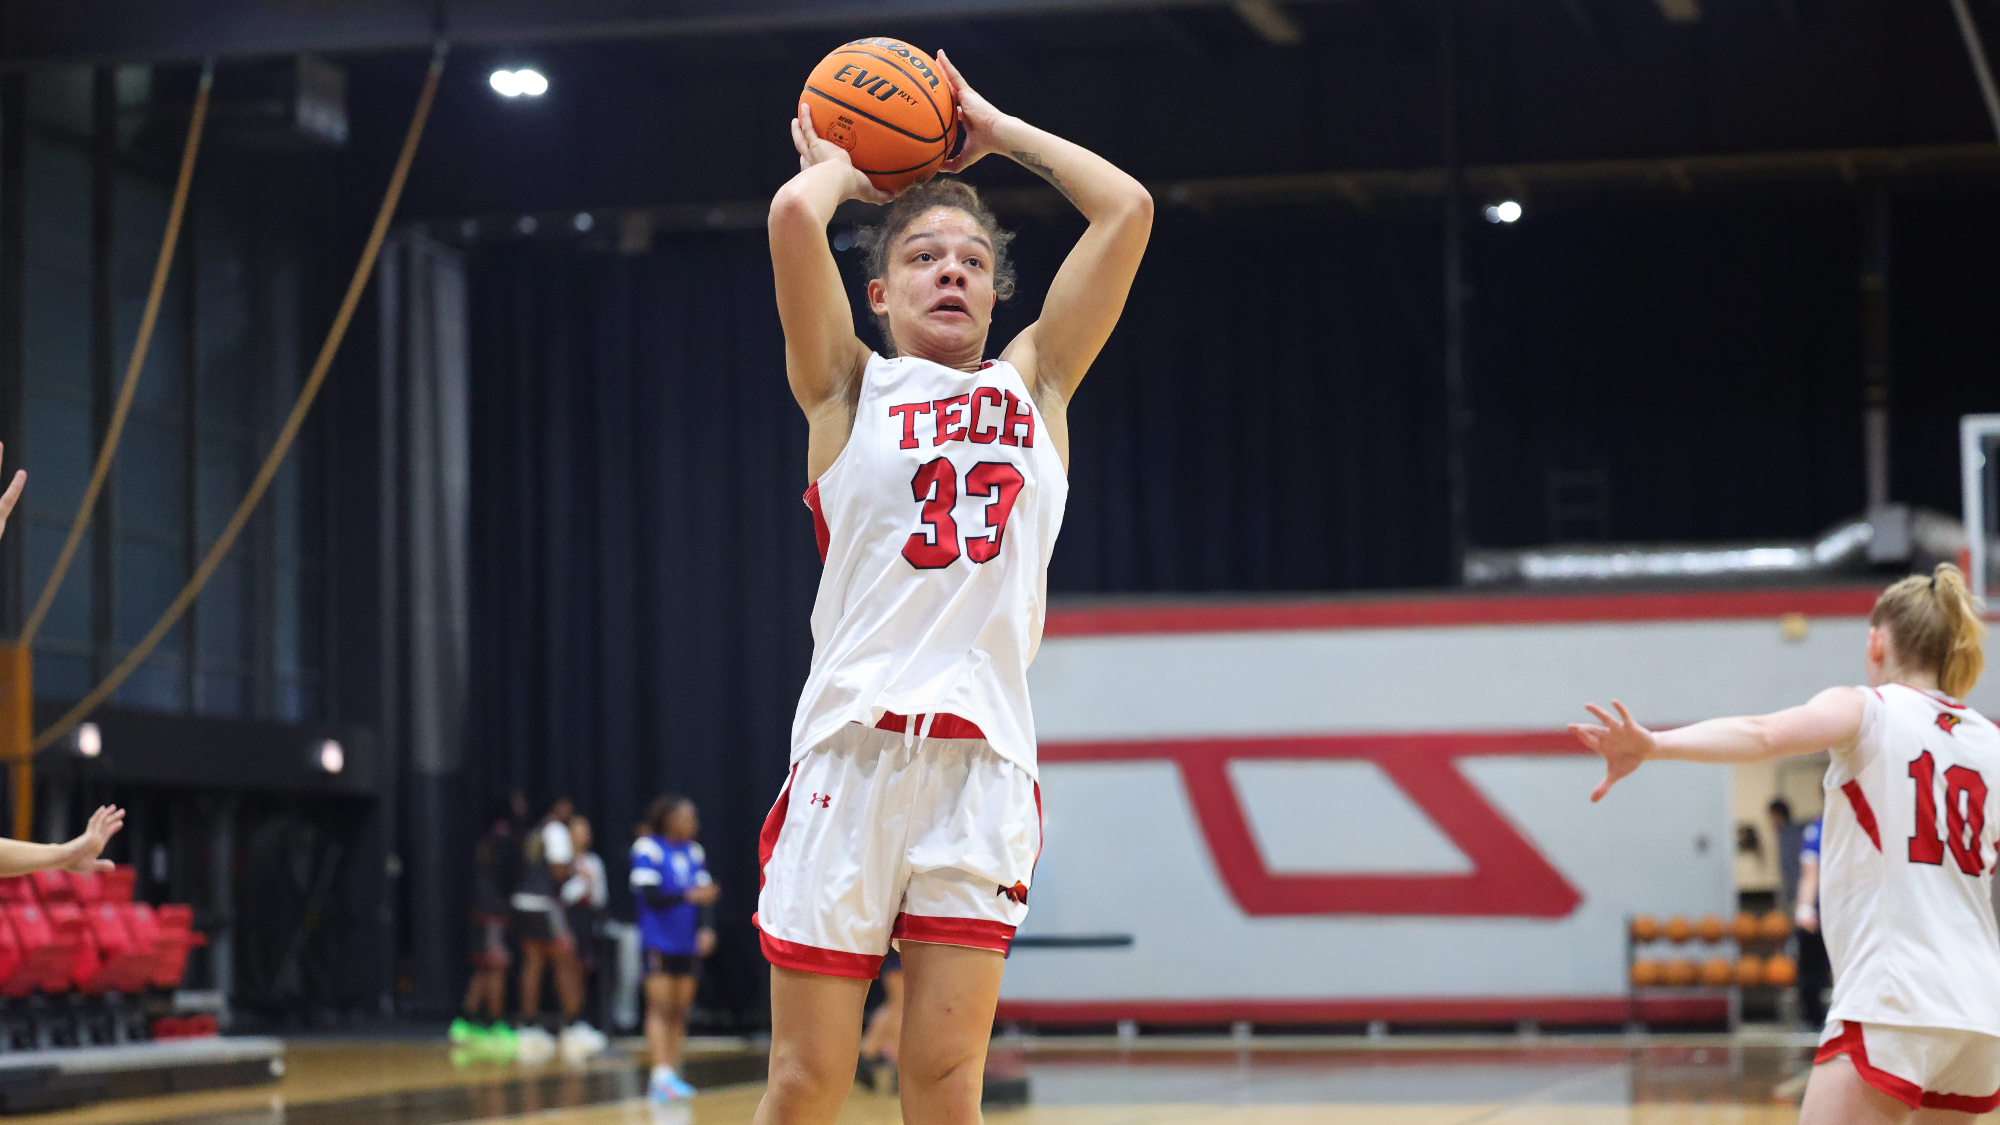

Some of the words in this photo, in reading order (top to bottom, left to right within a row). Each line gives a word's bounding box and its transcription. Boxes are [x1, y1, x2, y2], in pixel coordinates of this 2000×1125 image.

[833, 63, 900, 101] EVO
[898, 90, 919, 106] NXT
[889, 386, 1036, 450] TECH
[901, 456, 1025, 570] 33
[1908, 748, 1989, 877] 10
